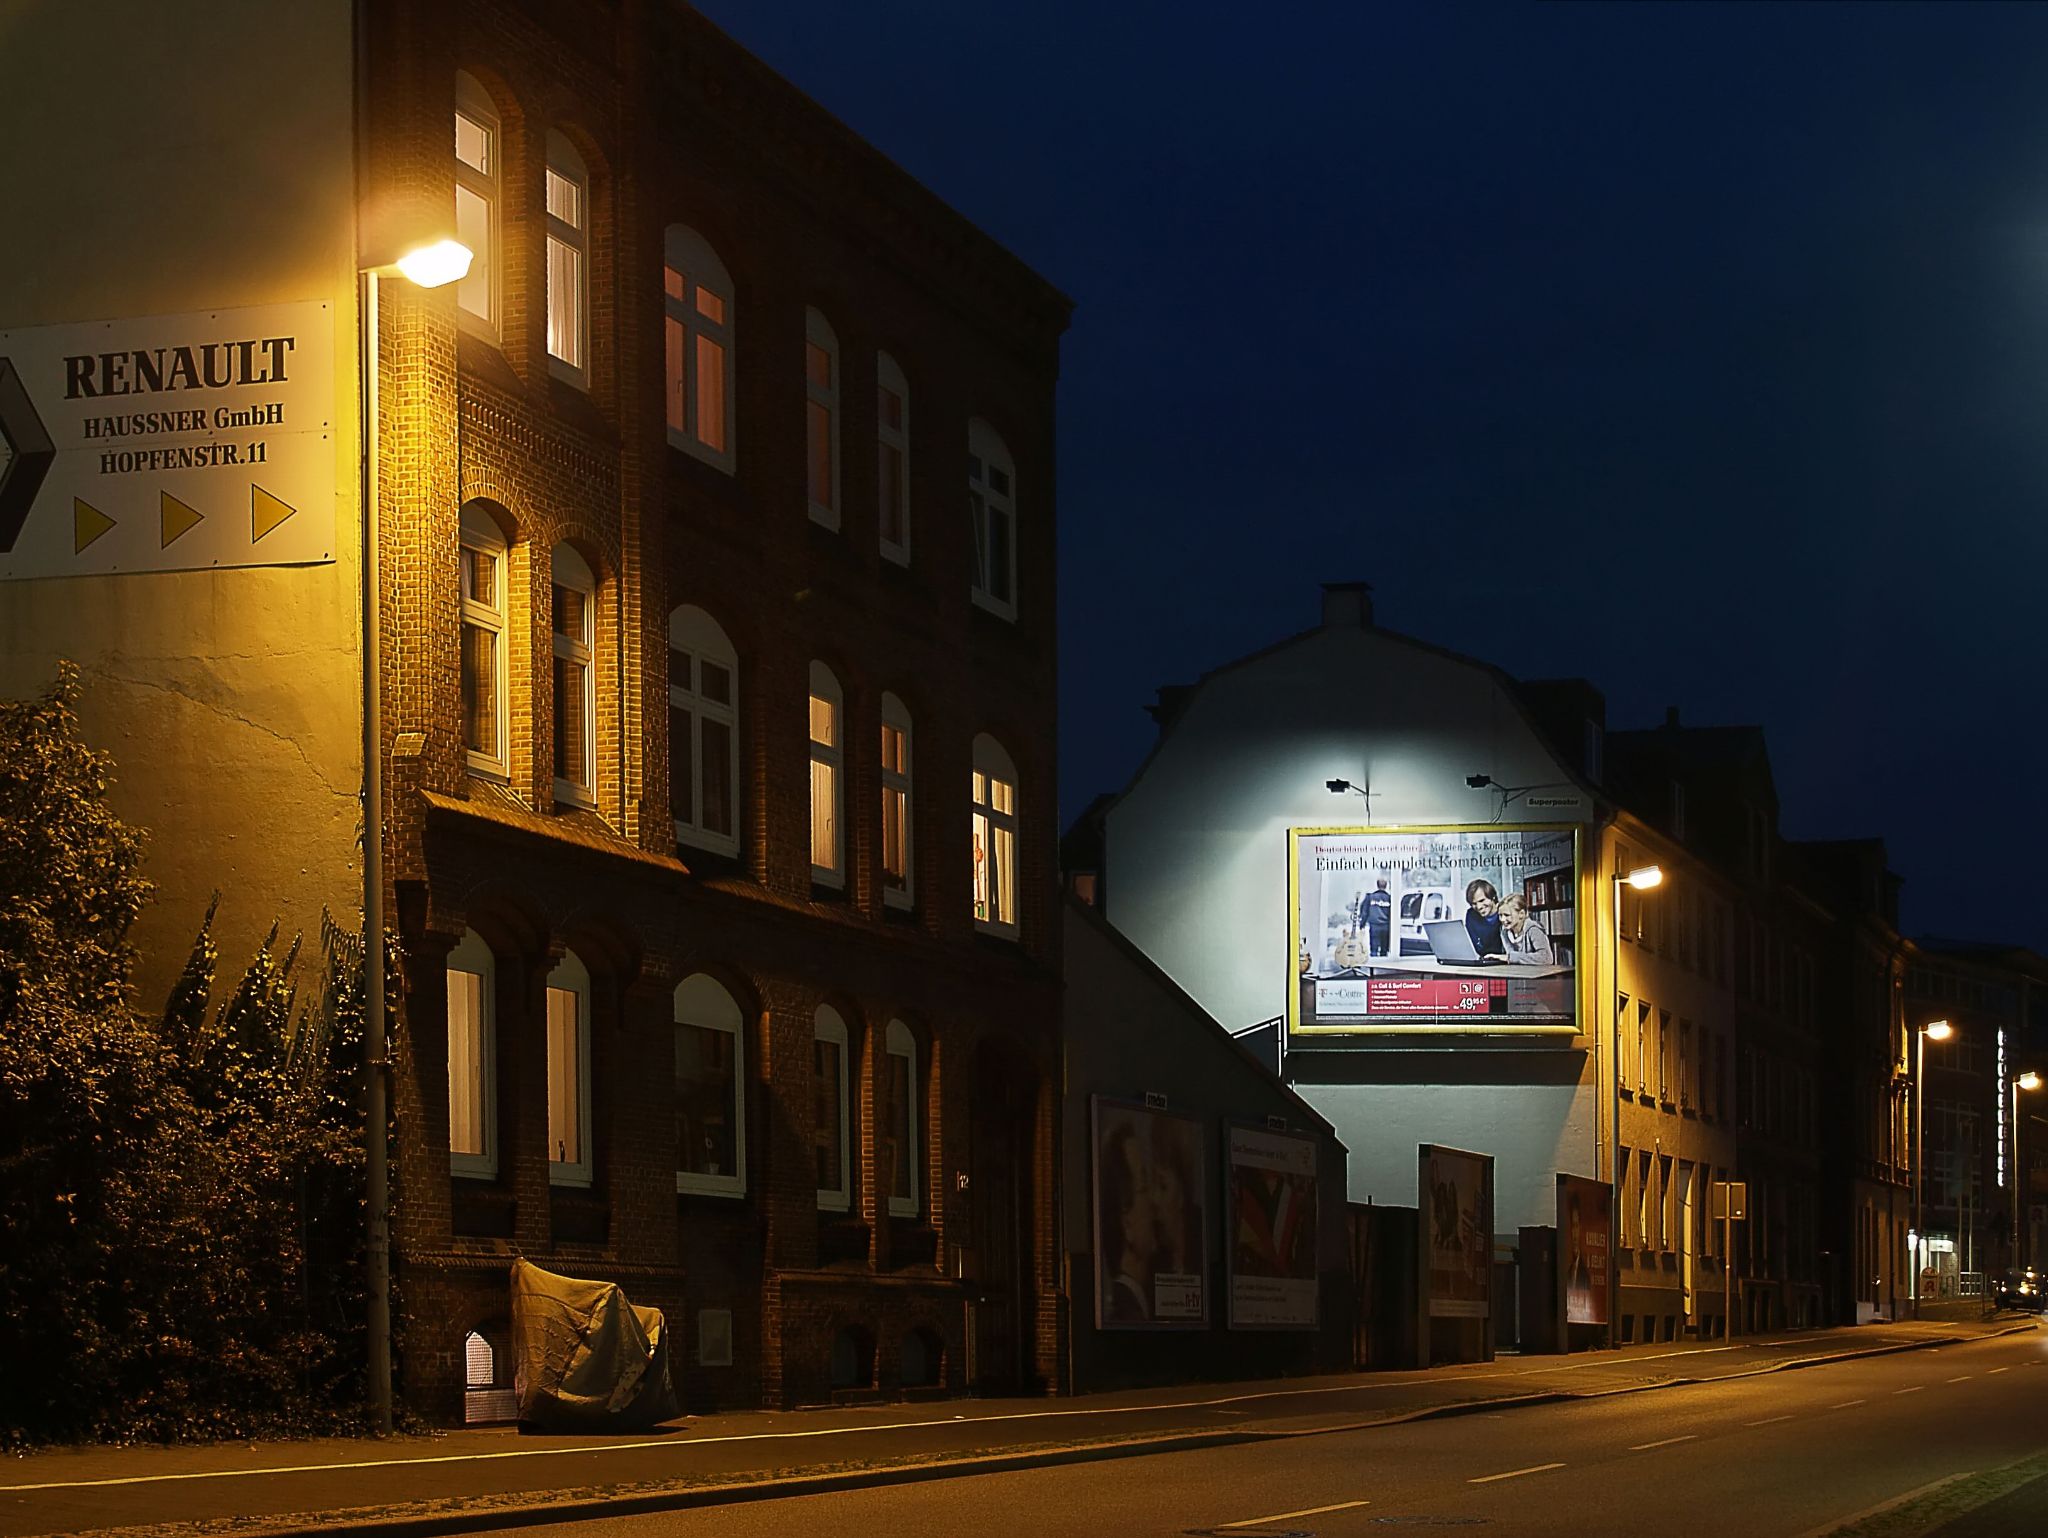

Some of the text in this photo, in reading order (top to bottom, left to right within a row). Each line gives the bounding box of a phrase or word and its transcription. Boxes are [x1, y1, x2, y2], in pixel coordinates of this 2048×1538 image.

[63, 337, 295, 400] RENAULT
[83, 403, 284, 439] HAUSSNER GmbH
[1316, 856, 1368, 871] Einfach
[1440, 854, 1502, 870] Komplett
